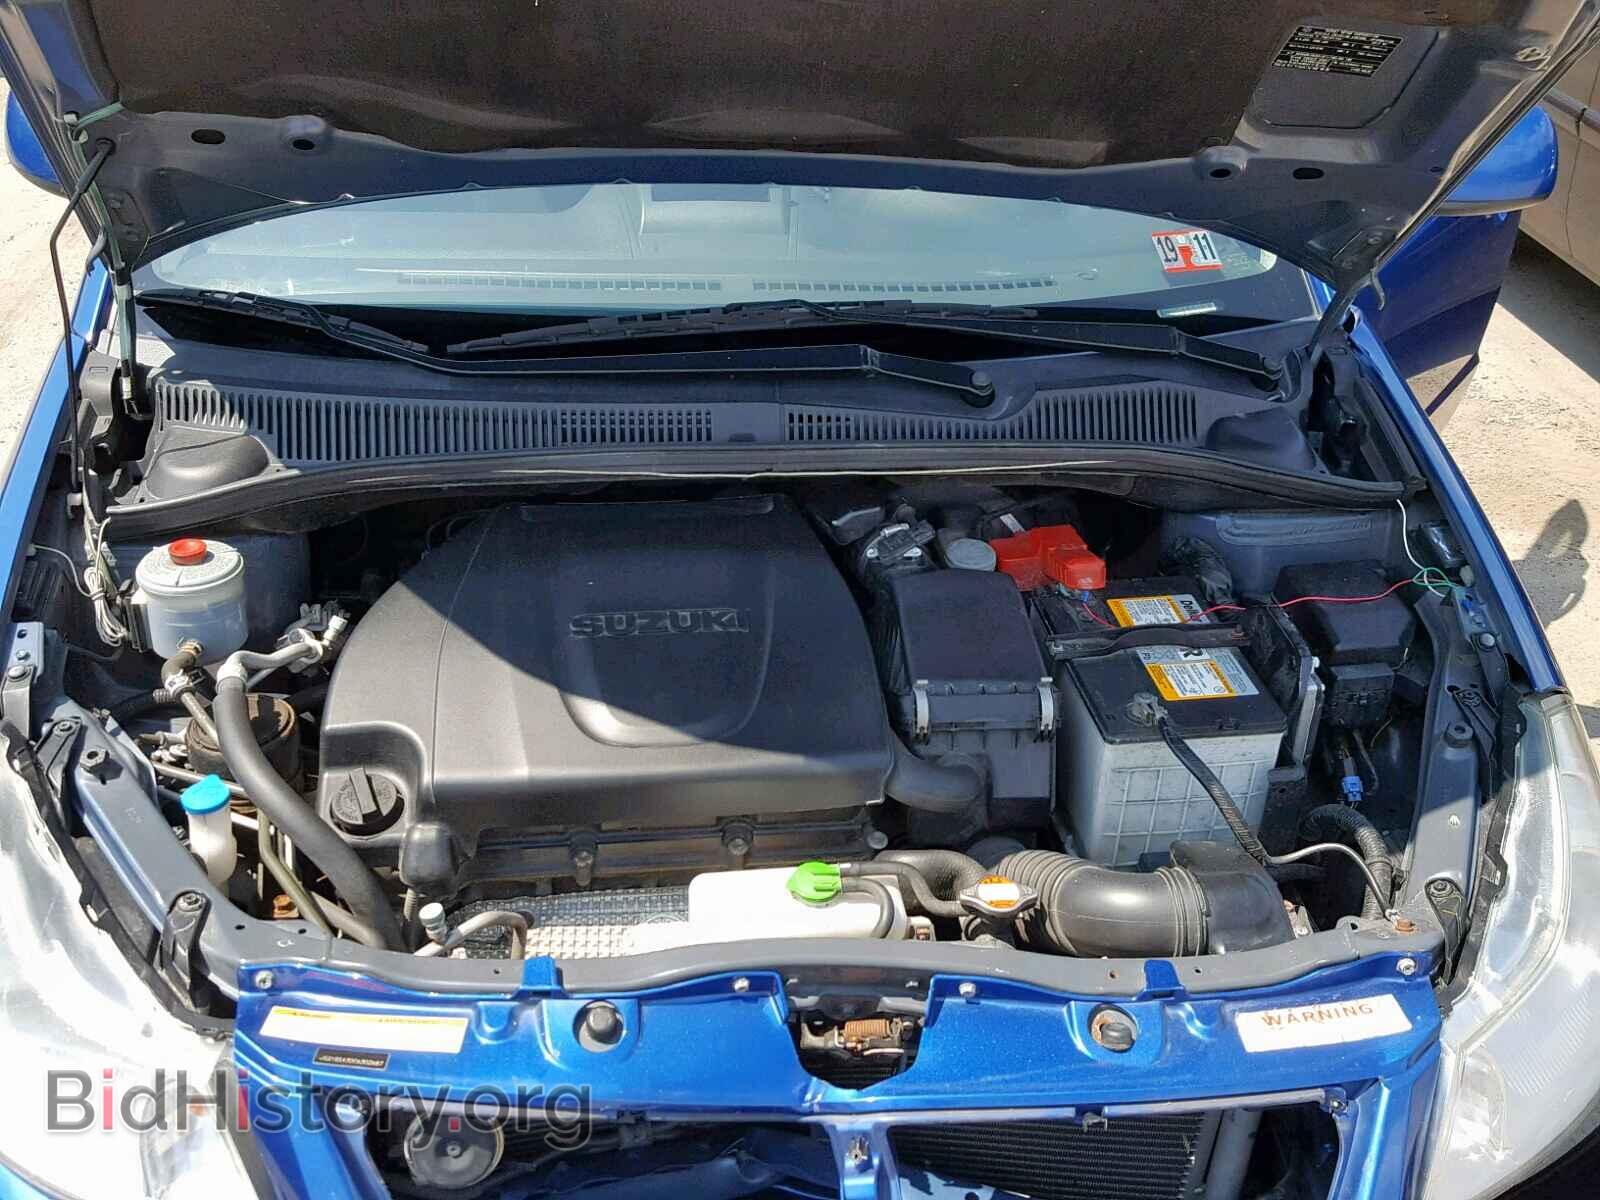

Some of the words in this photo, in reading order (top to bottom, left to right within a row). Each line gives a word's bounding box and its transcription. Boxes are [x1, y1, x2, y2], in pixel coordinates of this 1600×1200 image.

[1157, 236, 1178, 262] 19
[1192, 233, 1216, 260] 11
[569, 607, 750, 640] SUZUKI
[1261, 1003, 1374, 1027] WARNING
